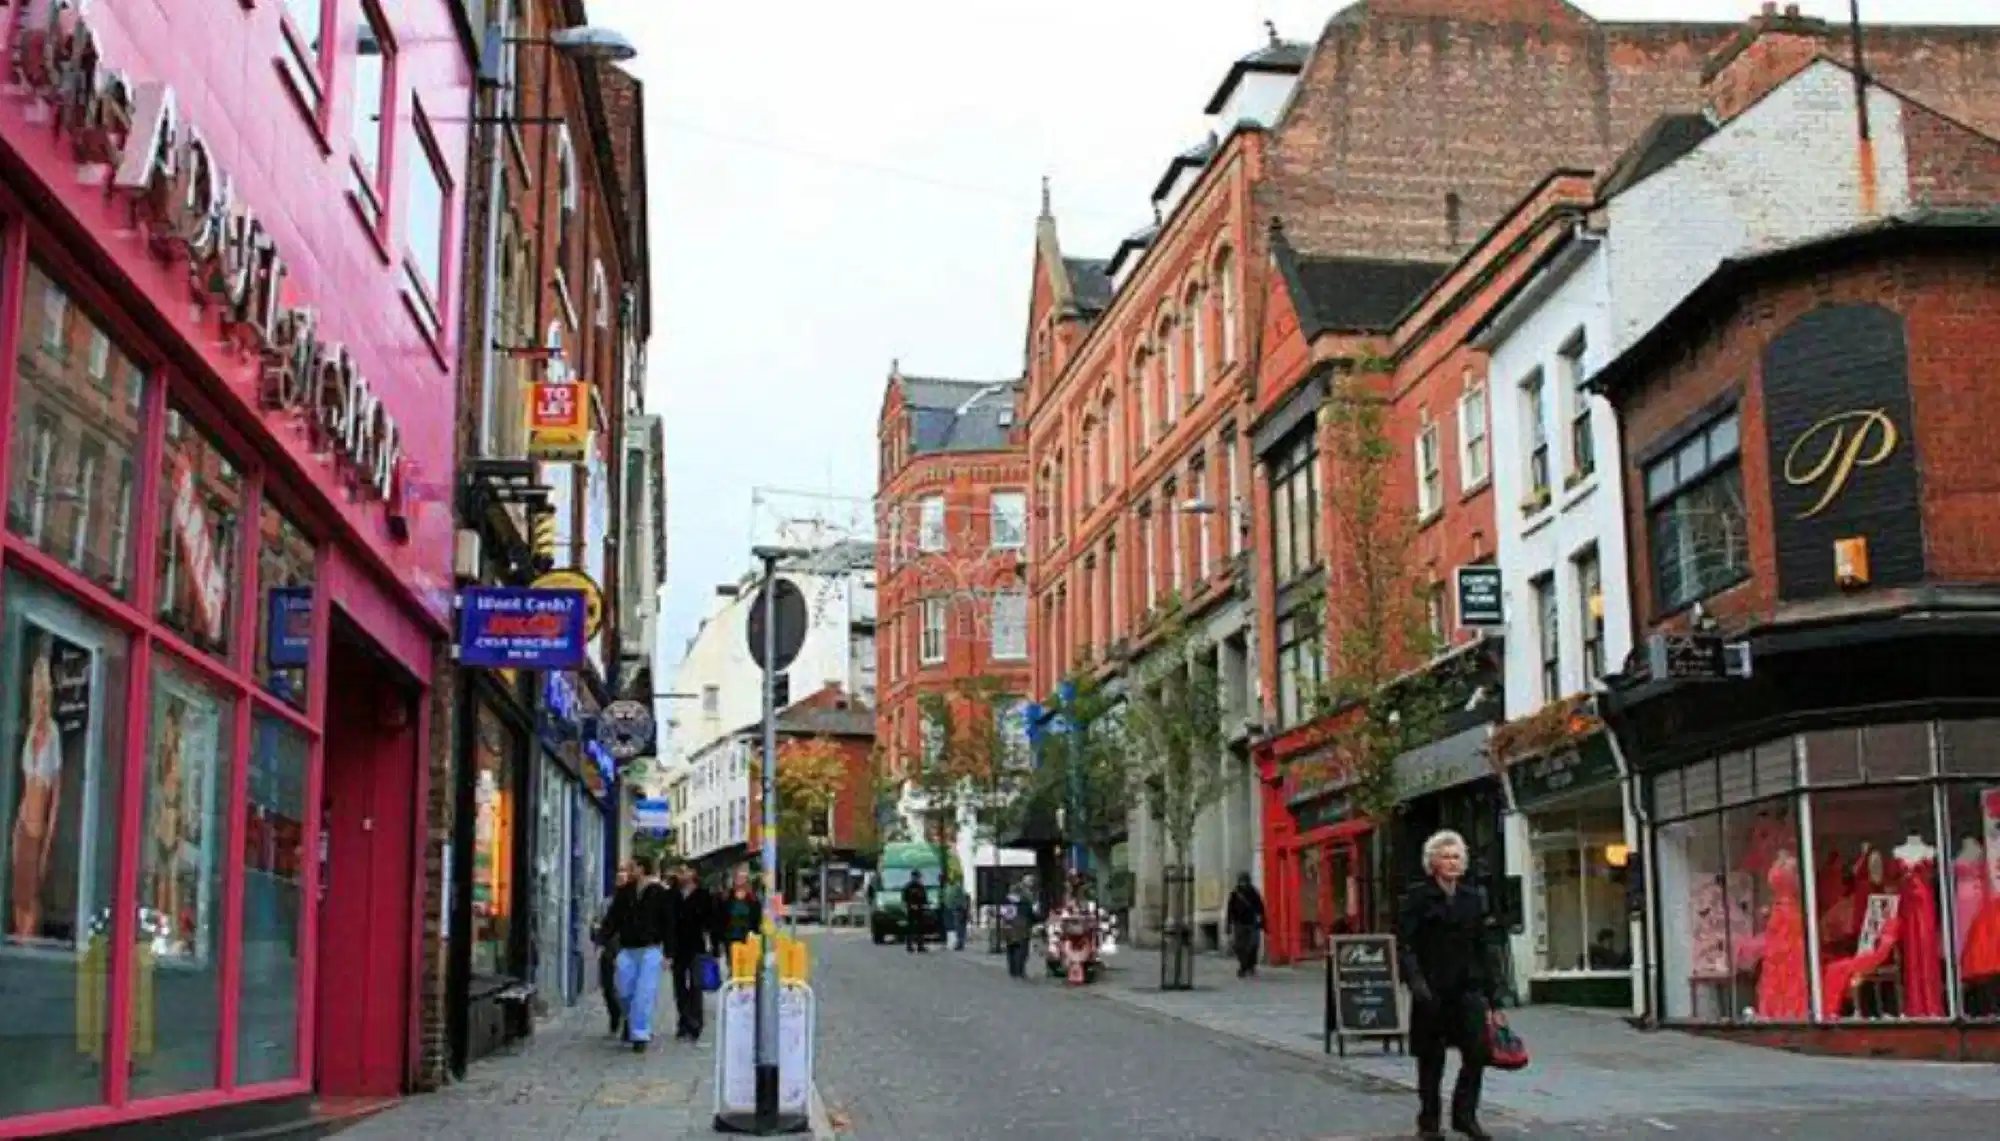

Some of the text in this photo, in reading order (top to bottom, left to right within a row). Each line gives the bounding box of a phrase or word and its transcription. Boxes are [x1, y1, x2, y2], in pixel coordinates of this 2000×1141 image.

[543, 387, 569, 401] TO
[538, 401, 576, 415] LET
[1783, 406, 1897, 520] P
